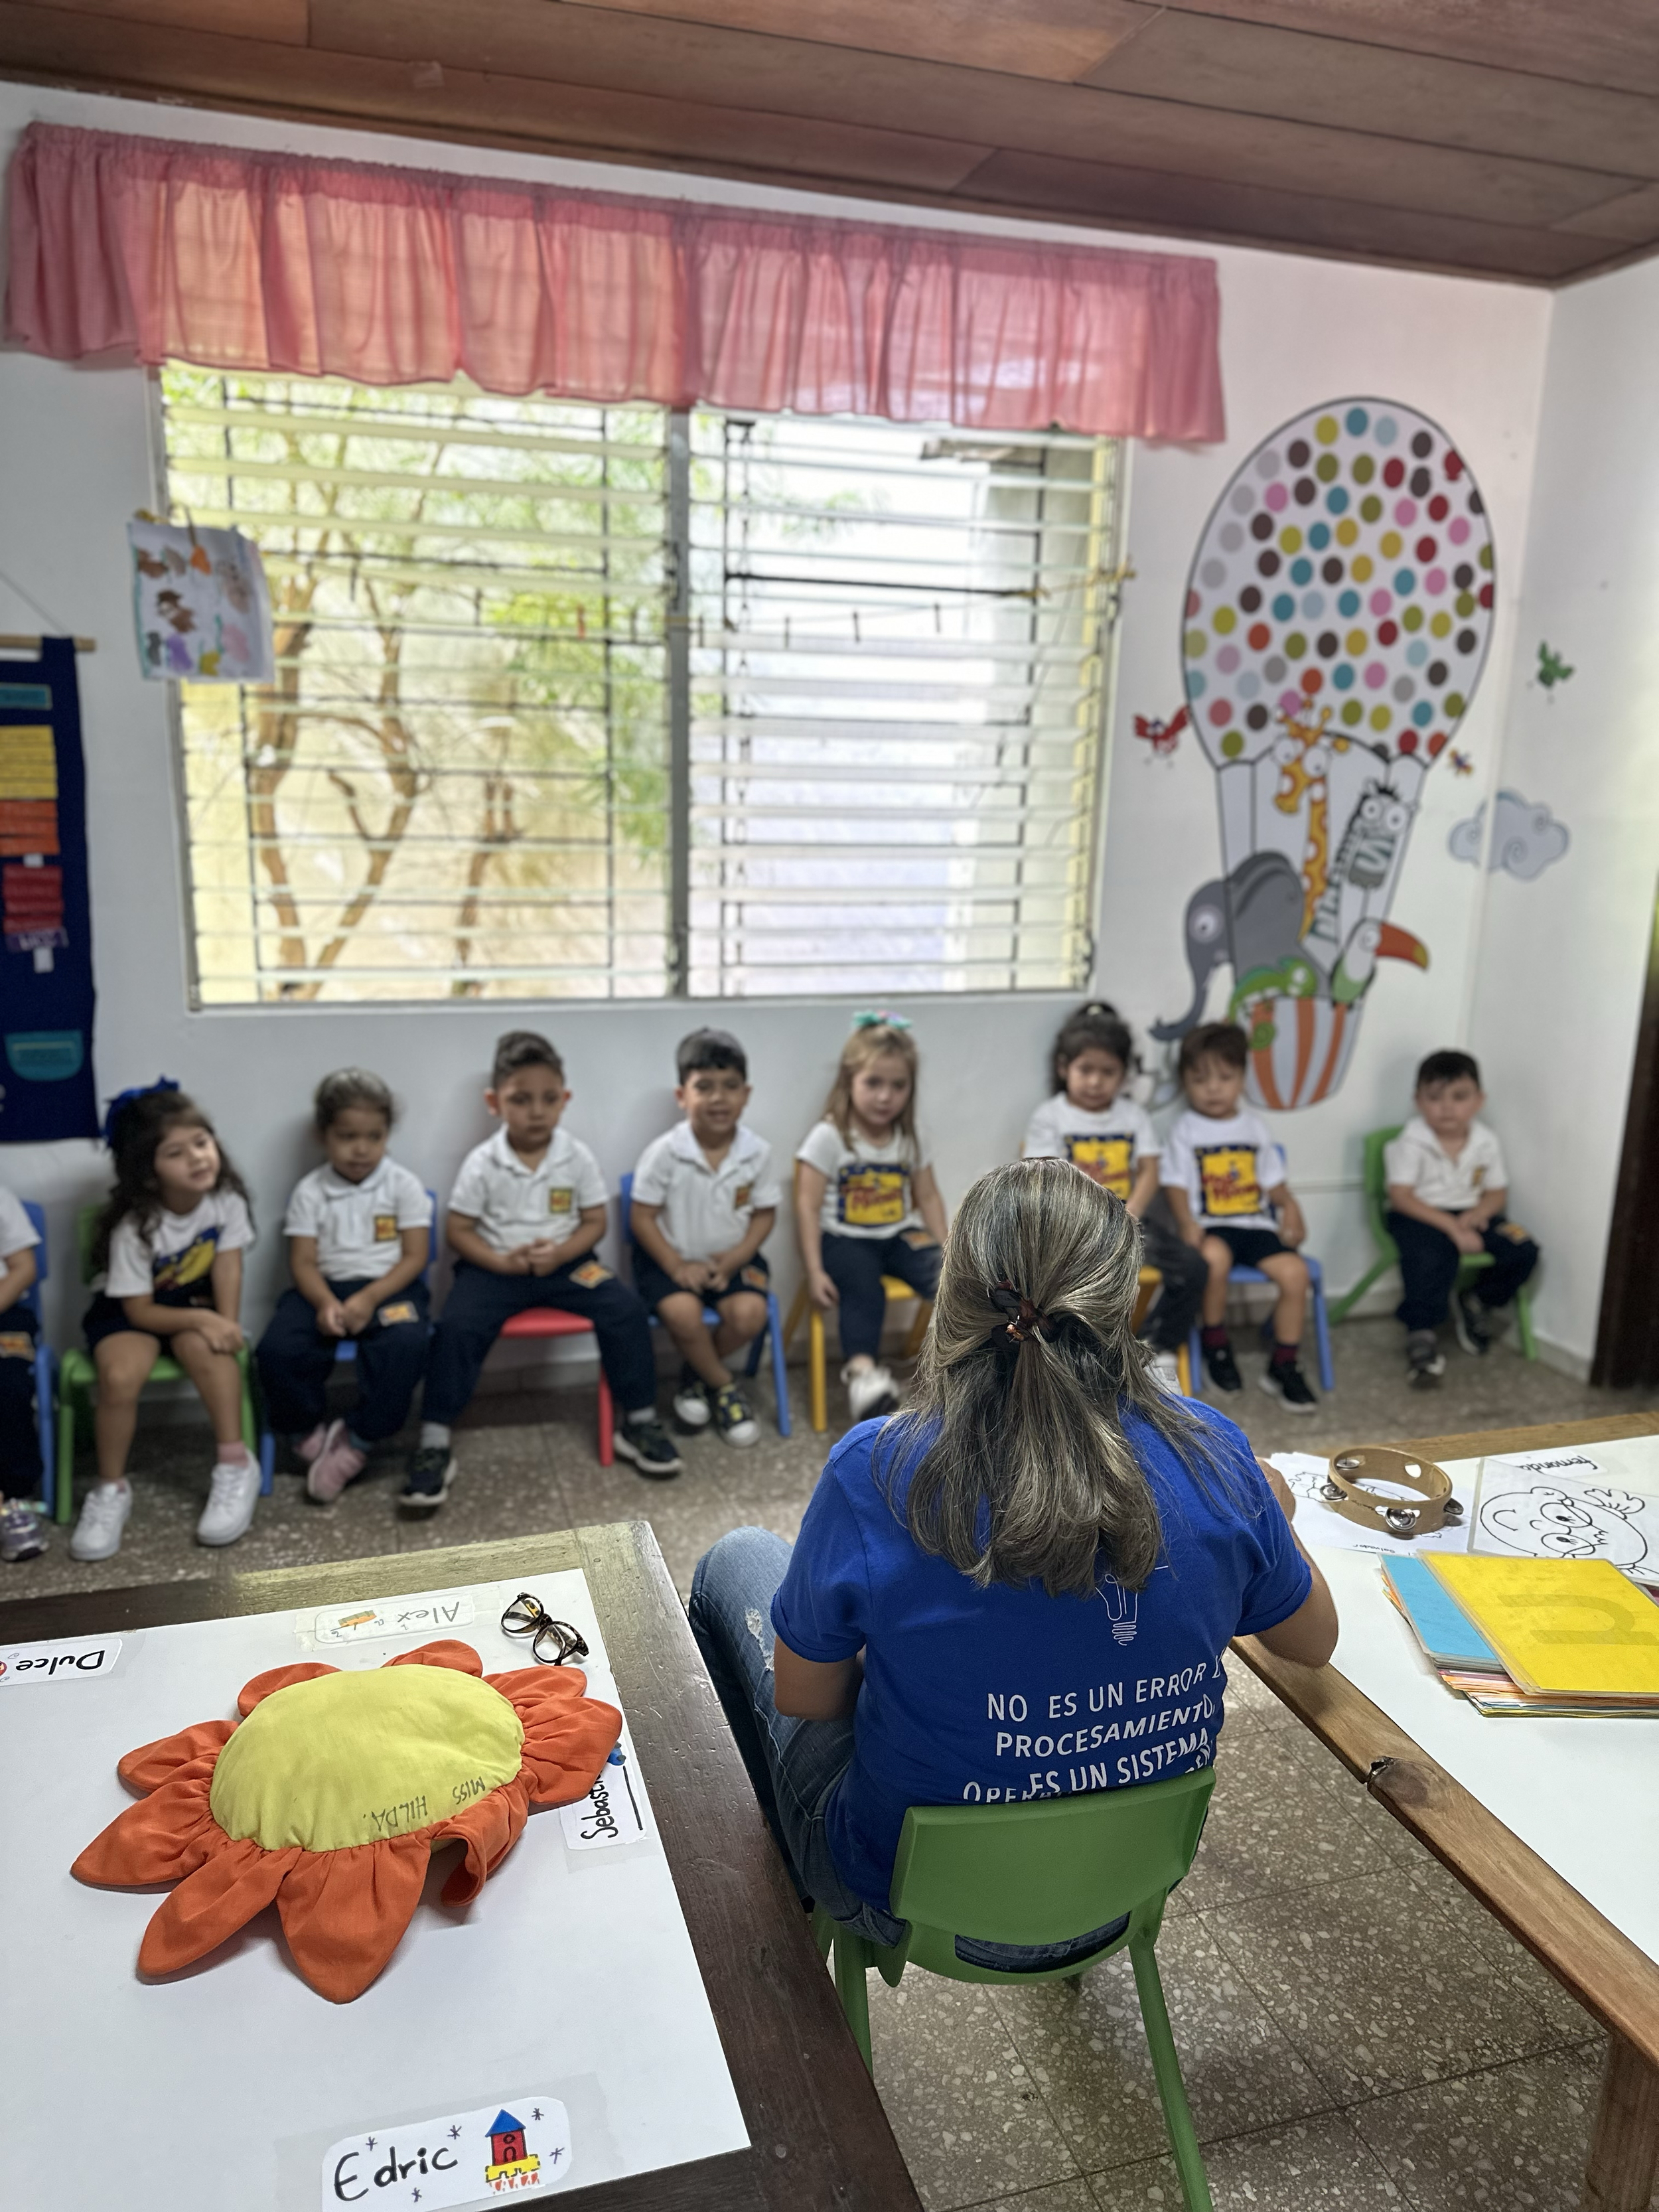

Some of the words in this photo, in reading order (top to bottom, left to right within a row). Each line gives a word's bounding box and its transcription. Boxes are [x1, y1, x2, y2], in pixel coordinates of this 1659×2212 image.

[397, 1601, 460, 1624] Alex
[15, 1650, 106, 1675] Dulce
[987, 1692, 1028, 1723] NO
[1048, 1692, 1078, 1720] ES
[1088, 1682, 1123, 1712] UN
[1135, 1662, 1207, 1704] ERROR
[1029, 1770, 1061, 1795] ES
[1069, 1762, 1108, 1792] UN
[1117, 1727, 1208, 1784] SISTEMA
[452, 1775, 486, 1805] MISS
[334, 2146, 459, 2201] Edric
